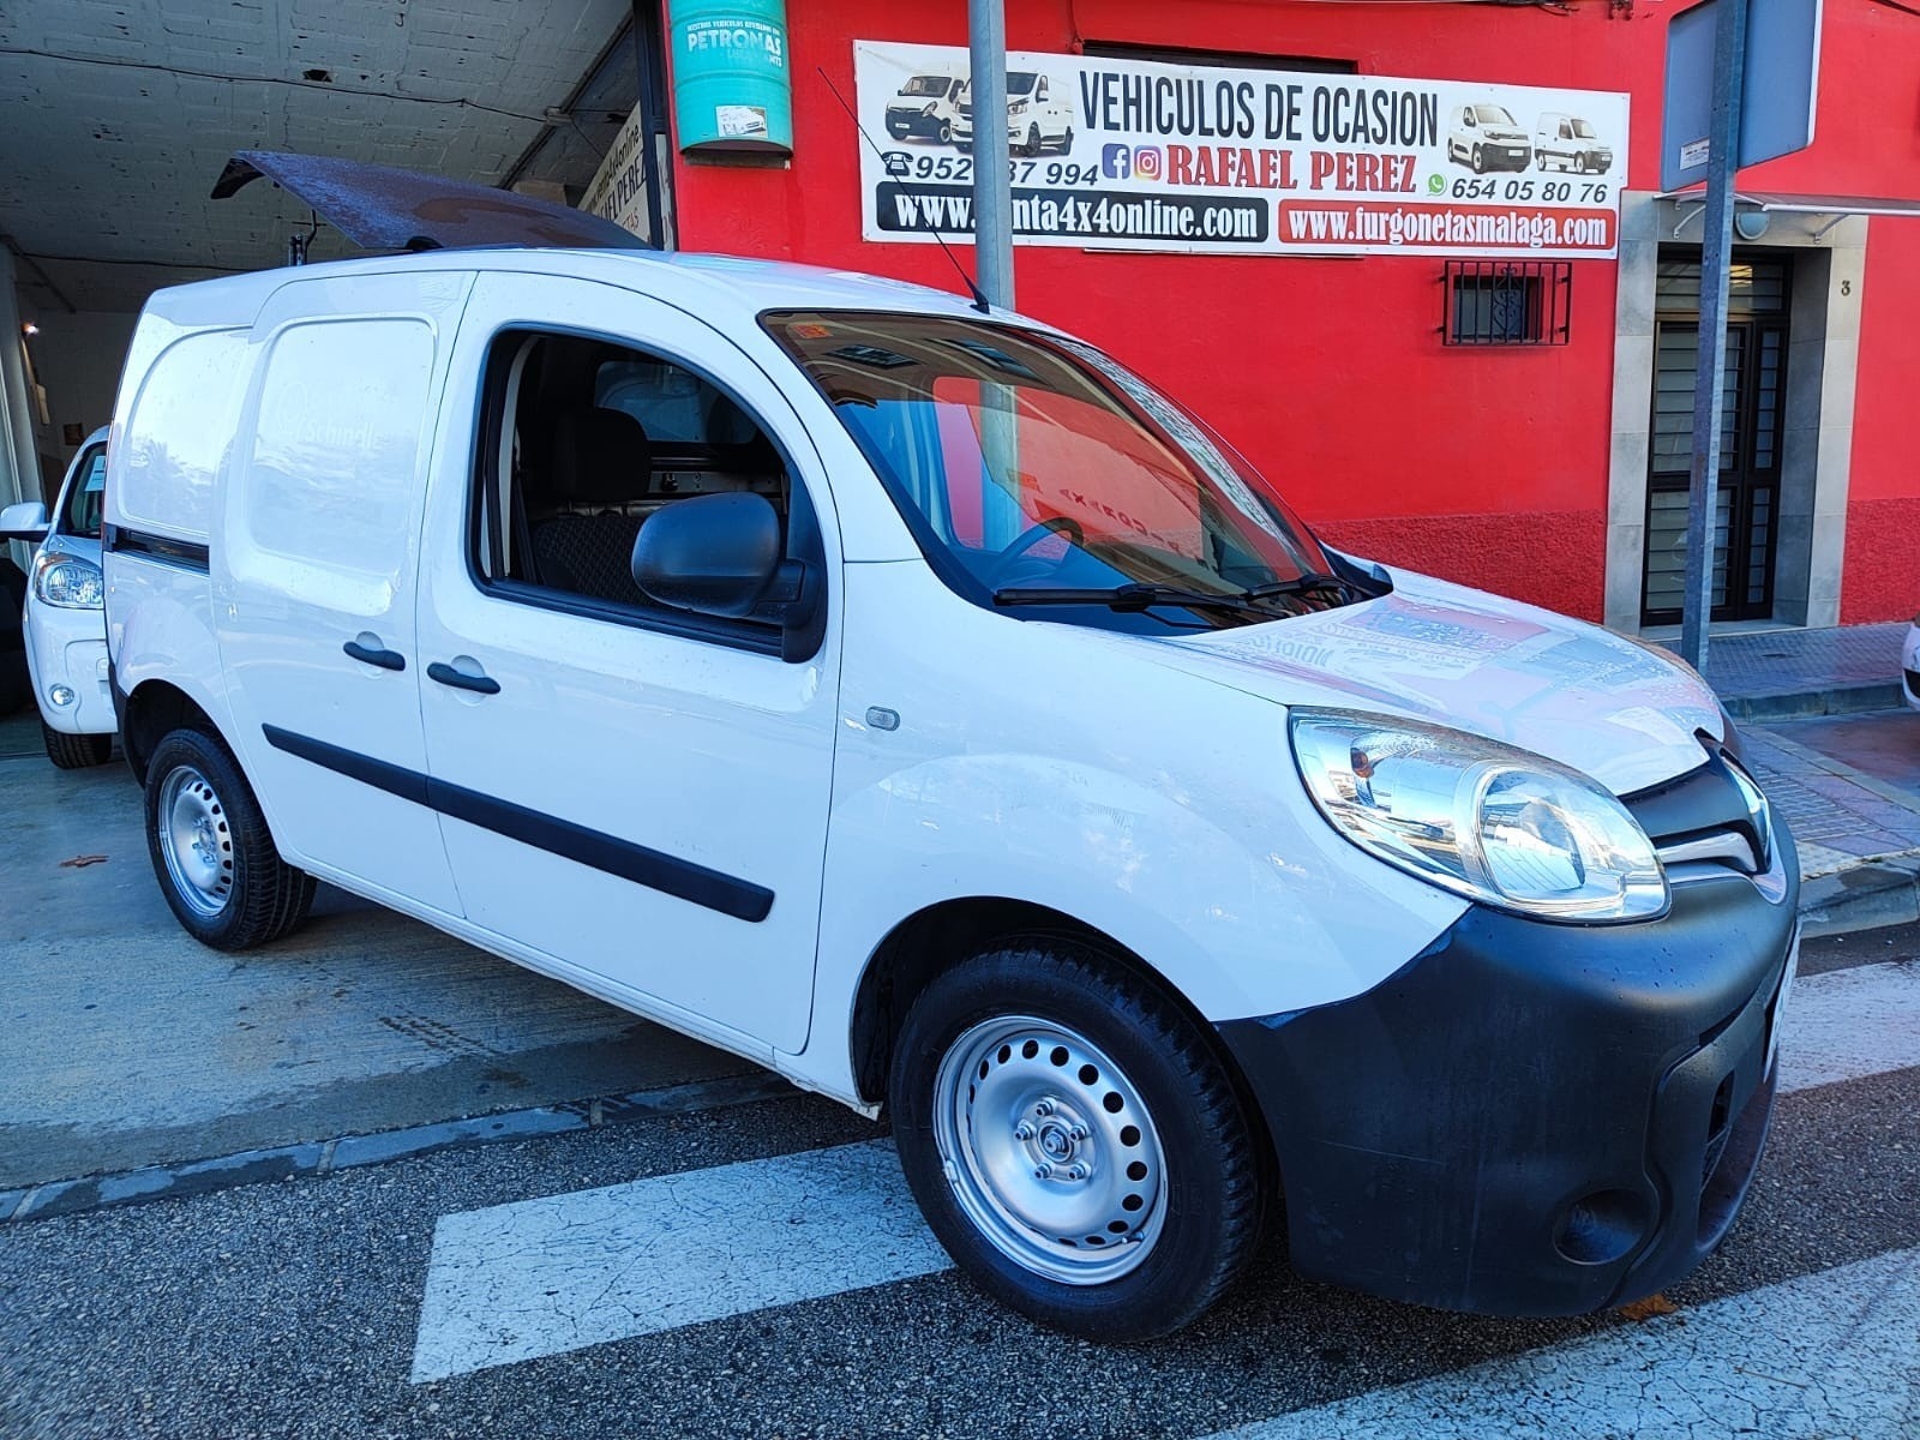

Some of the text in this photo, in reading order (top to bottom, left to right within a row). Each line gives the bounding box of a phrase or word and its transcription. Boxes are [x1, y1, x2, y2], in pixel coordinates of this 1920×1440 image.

[687, 29, 782, 56] PETRONAS
[1079, 71, 1438, 147] VEHICULOS DE OCASION
[915, 156, 973, 181] 952
[1045, 162, 1099, 186] 994
[1166, 144, 1417, 193] RAFAEL PEREZ
[1451, 178, 1608, 204] 654 05 80 76
[894, 193, 1258, 239] www.nta4x4online.com
[1289, 206, 1607, 247] www.furgonetasmalaga.com
[1841, 279, 1851, 296] 3
